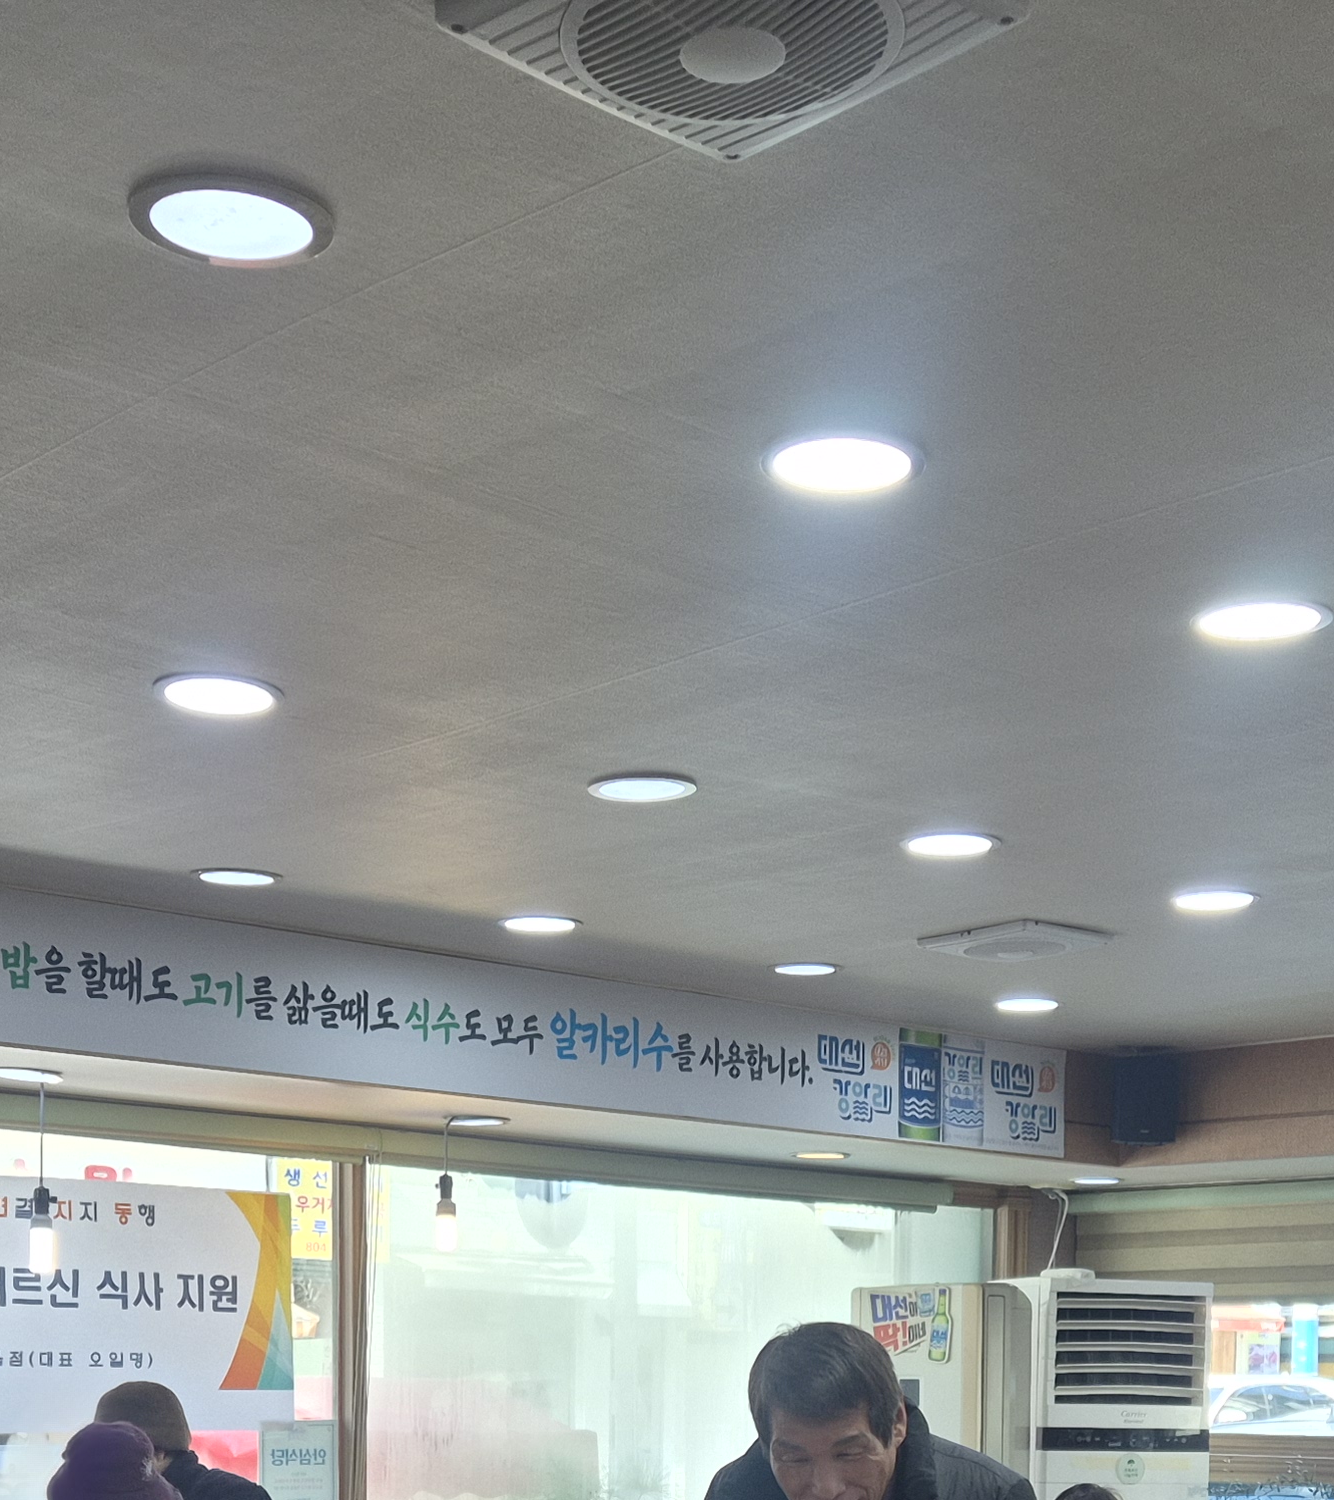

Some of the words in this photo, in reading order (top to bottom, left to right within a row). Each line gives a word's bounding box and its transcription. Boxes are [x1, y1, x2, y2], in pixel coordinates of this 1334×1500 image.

[0, 940, 72, 995] 밥을
[77, 951, 179, 1005] 할때도
[182, 971, 278, 1021] 고기를
[282, 980, 400, 1034] 삶을때도
[405, 996, 488, 1045] 식수도
[490, 1013, 544, 1055] 모두
[550, 1007, 698, 1073] 알카리수를
[699, 1036, 814, 1087] 사용합니다.
[114, 1202, 156, 1227] 동행
[96, 1270, 164, 1311] 식사
[176, 1273, 238, 1313] 지원
[88, 1351, 153, 1369] 오일명)
